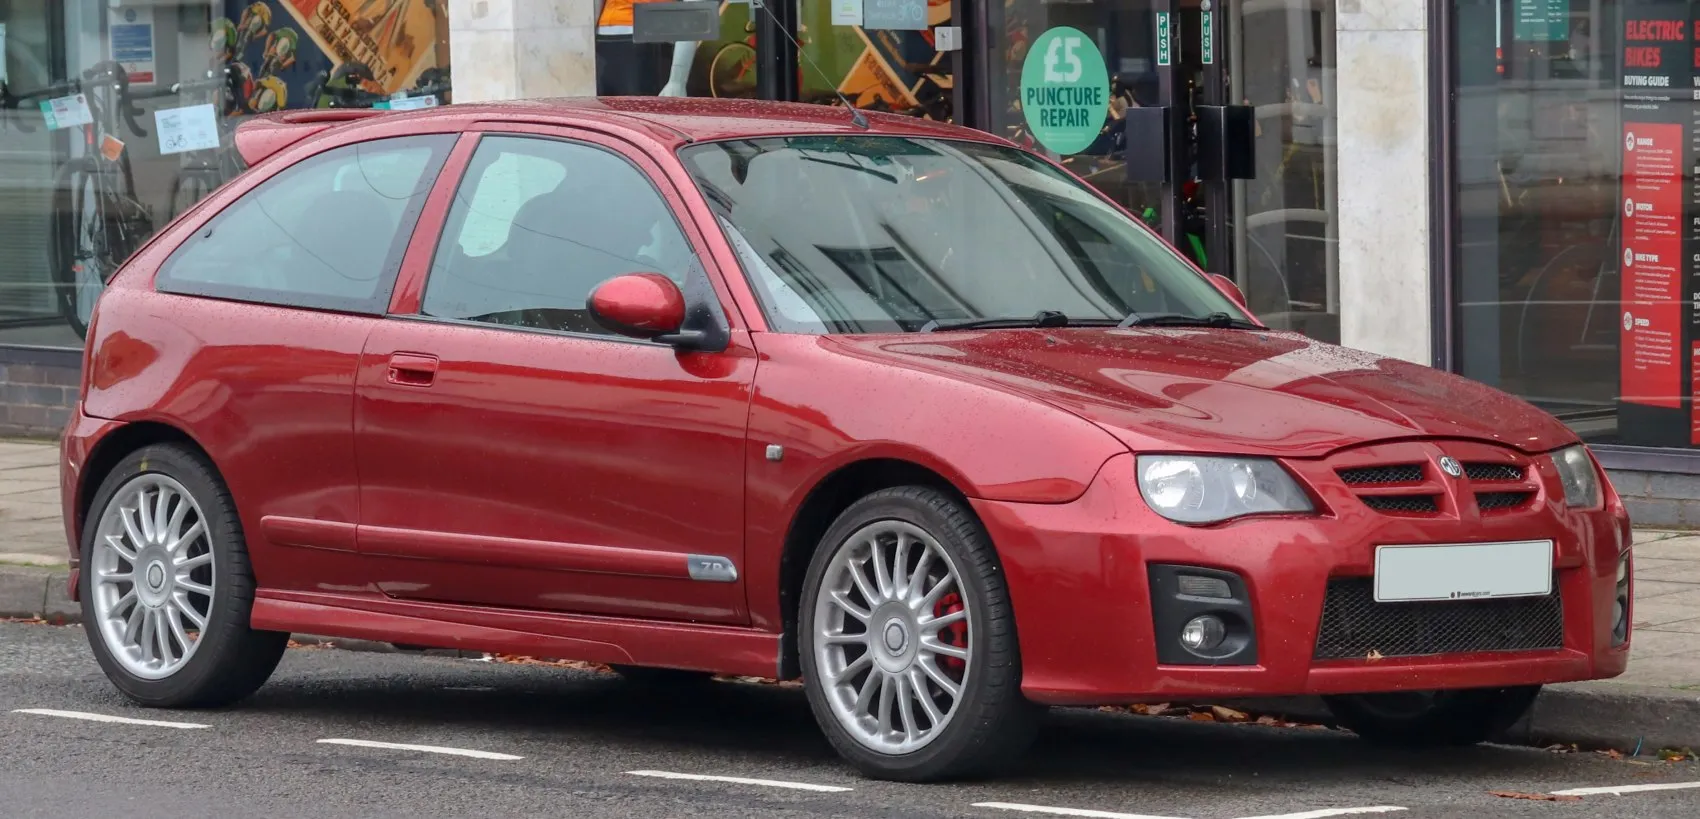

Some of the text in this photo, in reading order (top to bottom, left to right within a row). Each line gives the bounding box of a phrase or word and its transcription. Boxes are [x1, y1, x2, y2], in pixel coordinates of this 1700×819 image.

[1159, 15, 1168, 61] PUSH
[1203, 14, 1211, 59] PUSH
[1625, 19, 1685, 41] ELECTRIC
[1043, 35, 1083, 83] £5
[1624, 46, 1662, 68] BIKES
[1624, 75, 1670, 87] BUYING GUIDE
[1026, 86, 1102, 106] PUNCTURE
[1040, 108, 1090, 127] REPAIR
